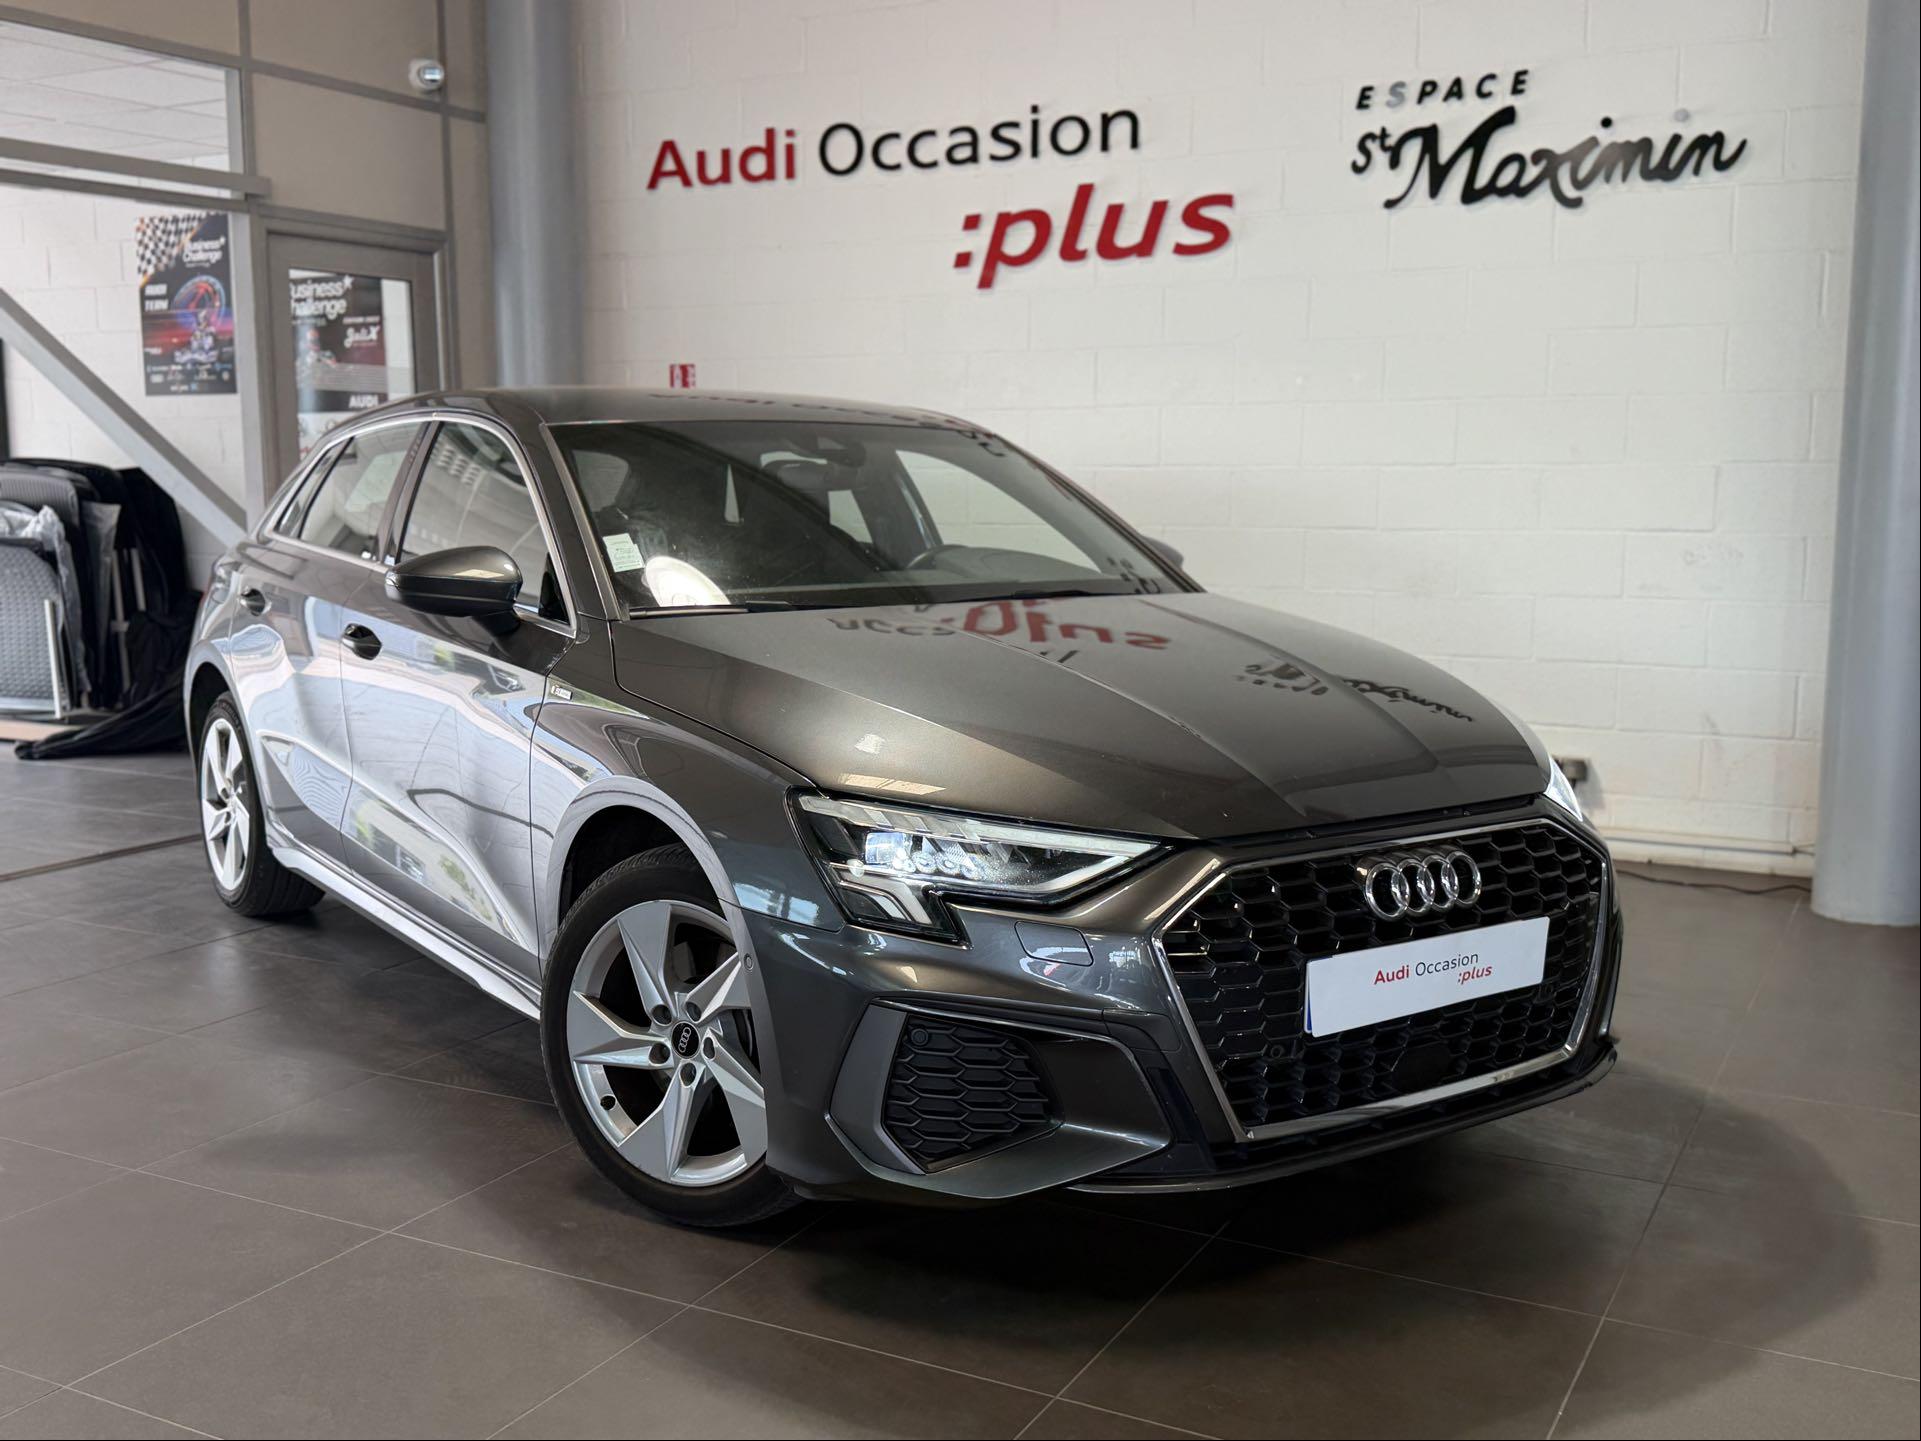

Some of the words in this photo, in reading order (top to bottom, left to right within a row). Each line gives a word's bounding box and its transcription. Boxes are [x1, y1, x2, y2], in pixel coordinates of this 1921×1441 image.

[1356, 69, 1530, 110] ESPACE
[646, 128, 796, 189] Audi
[819, 104, 1140, 177] Occasion
[1384, 106, 1747, 210] Maximin
[953, 183, 1235, 290] :plus
[1373, 965, 1410, 985] Audi
[1415, 952, 1479, 976] Occasion
[1457, 965, 1493, 985] :plus
